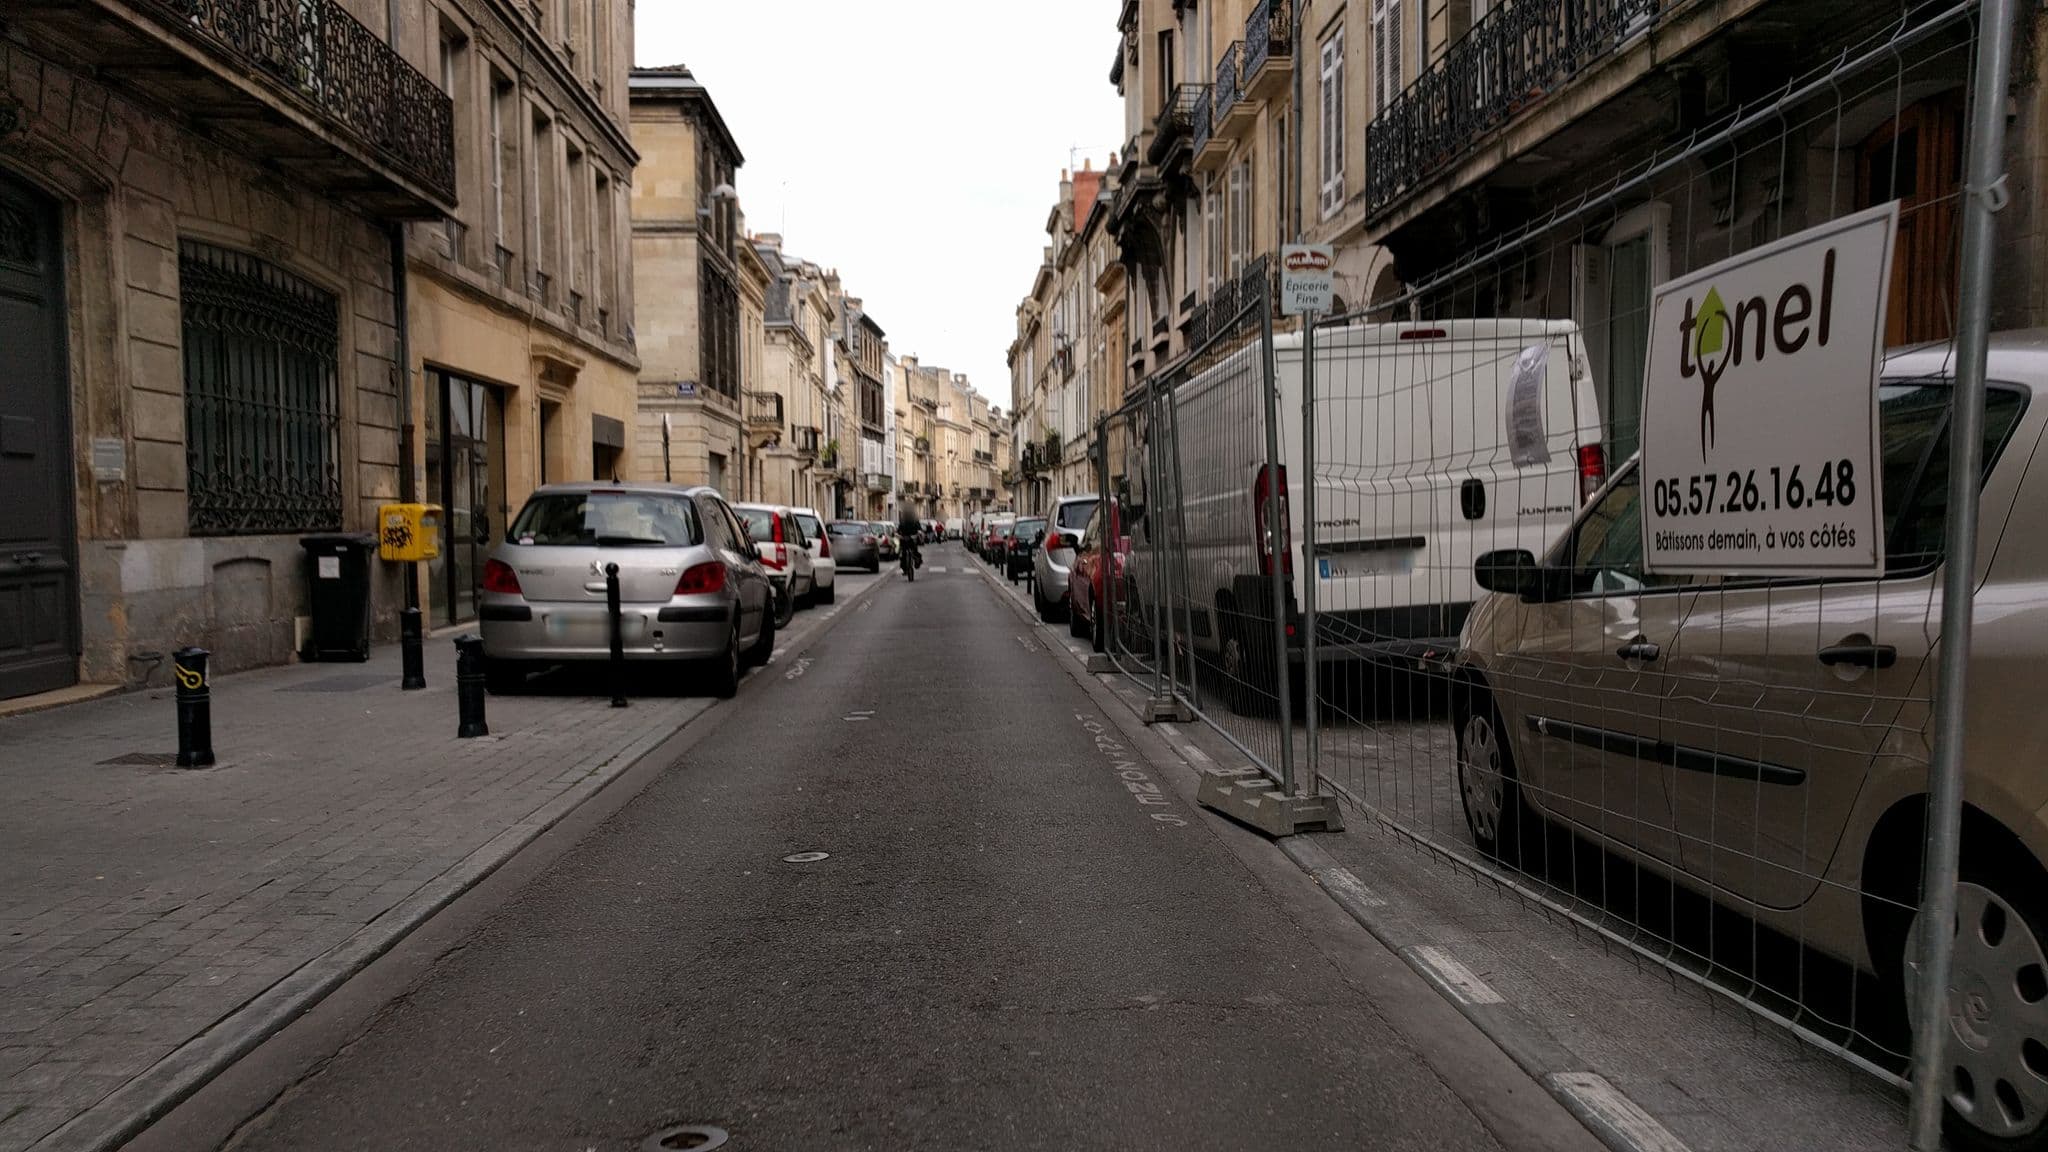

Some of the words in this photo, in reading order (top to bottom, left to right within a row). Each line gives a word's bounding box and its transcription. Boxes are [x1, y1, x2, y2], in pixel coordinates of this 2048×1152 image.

[1286, 278, 1329, 293] Épicerie
[1296, 294, 1319, 304] Fine
[1680, 248, 1836, 379] tonel
[1654, 459, 1856, 517] 05.57.26.16.48
[1516, 505, 1572, 515] JUMPER
[1656, 530, 1704, 551] Bâtissons
[1708, 528, 1761, 552] demain,
[1766, 525, 1775, 548] à
[1780, 529, 1805, 548] vos
[1810, 521, 1856, 548] côtés
